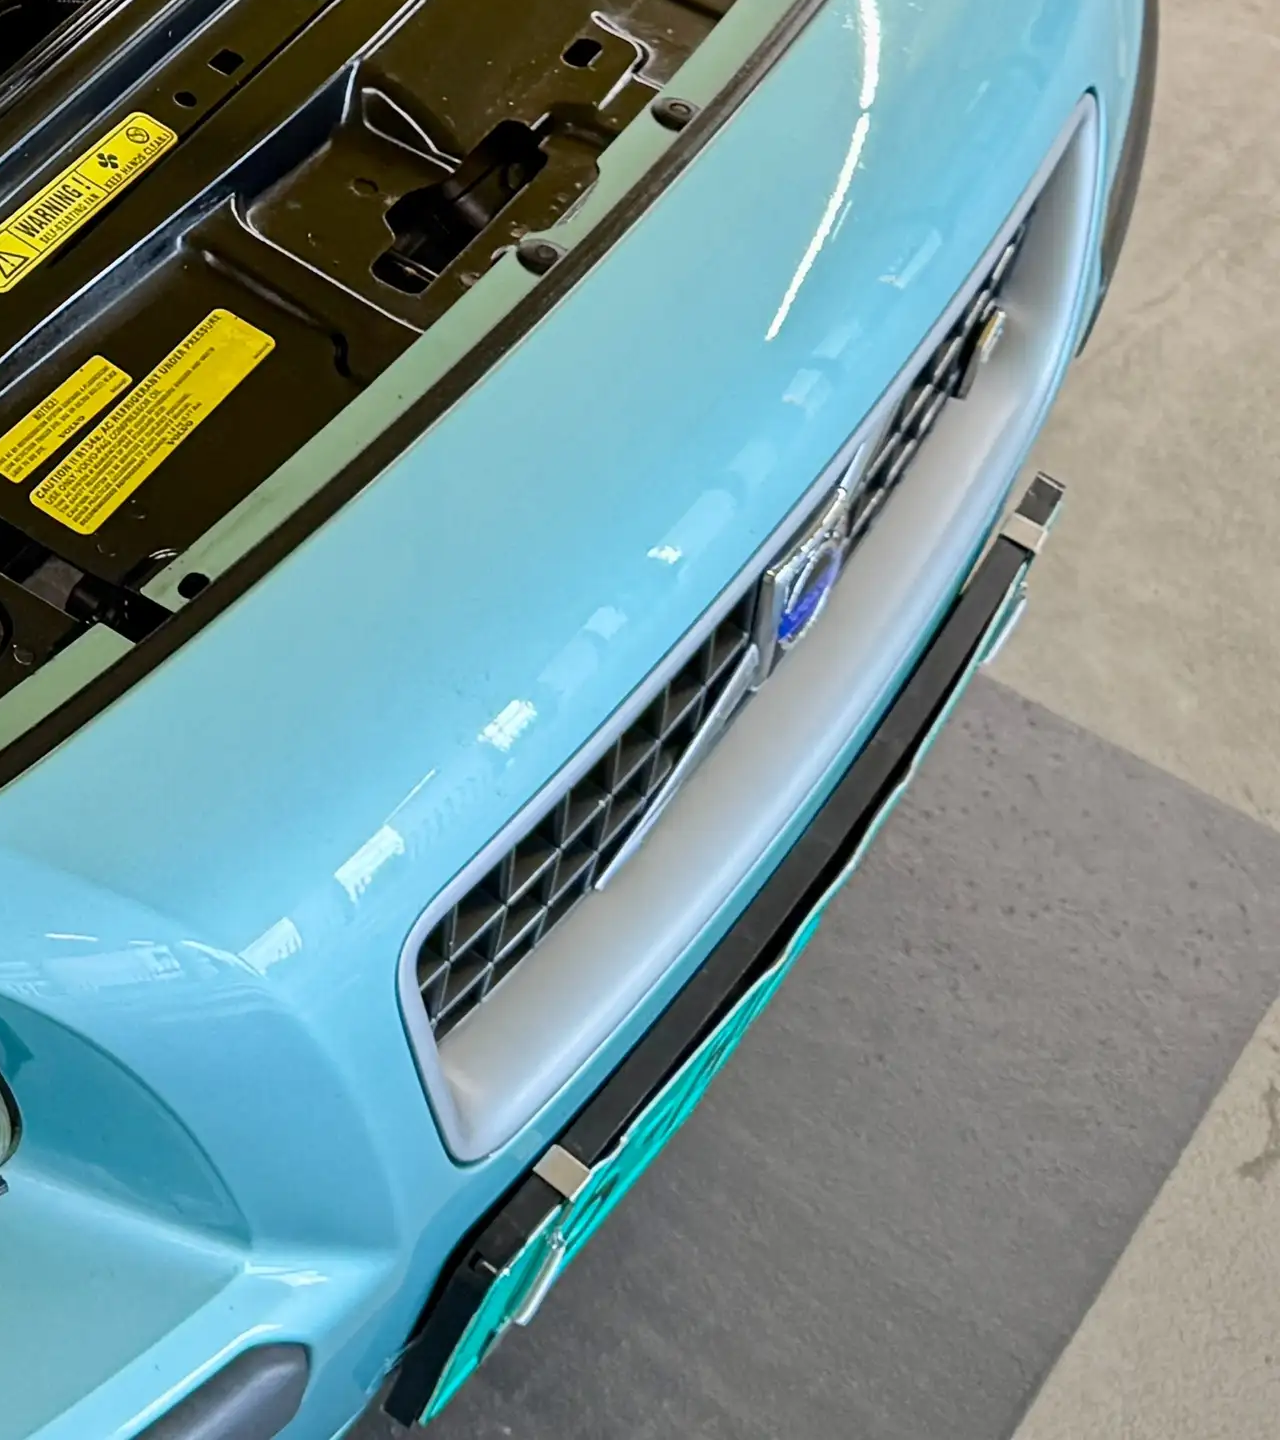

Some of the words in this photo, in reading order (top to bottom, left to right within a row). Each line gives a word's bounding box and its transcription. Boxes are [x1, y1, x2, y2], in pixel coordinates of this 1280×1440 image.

[14, 184, 83, 238] WARNING
[72, 177, 91, 190] !
[35, 464, 72, 499] CAUTION
[101, 421, 114, 434] AC
[111, 374, 161, 423] REFRIGERANT
[158, 350, 186, 374] UNDER
[183, 315, 221, 350] PRESSURE
[58, 416, 85, 438] VOLVO
